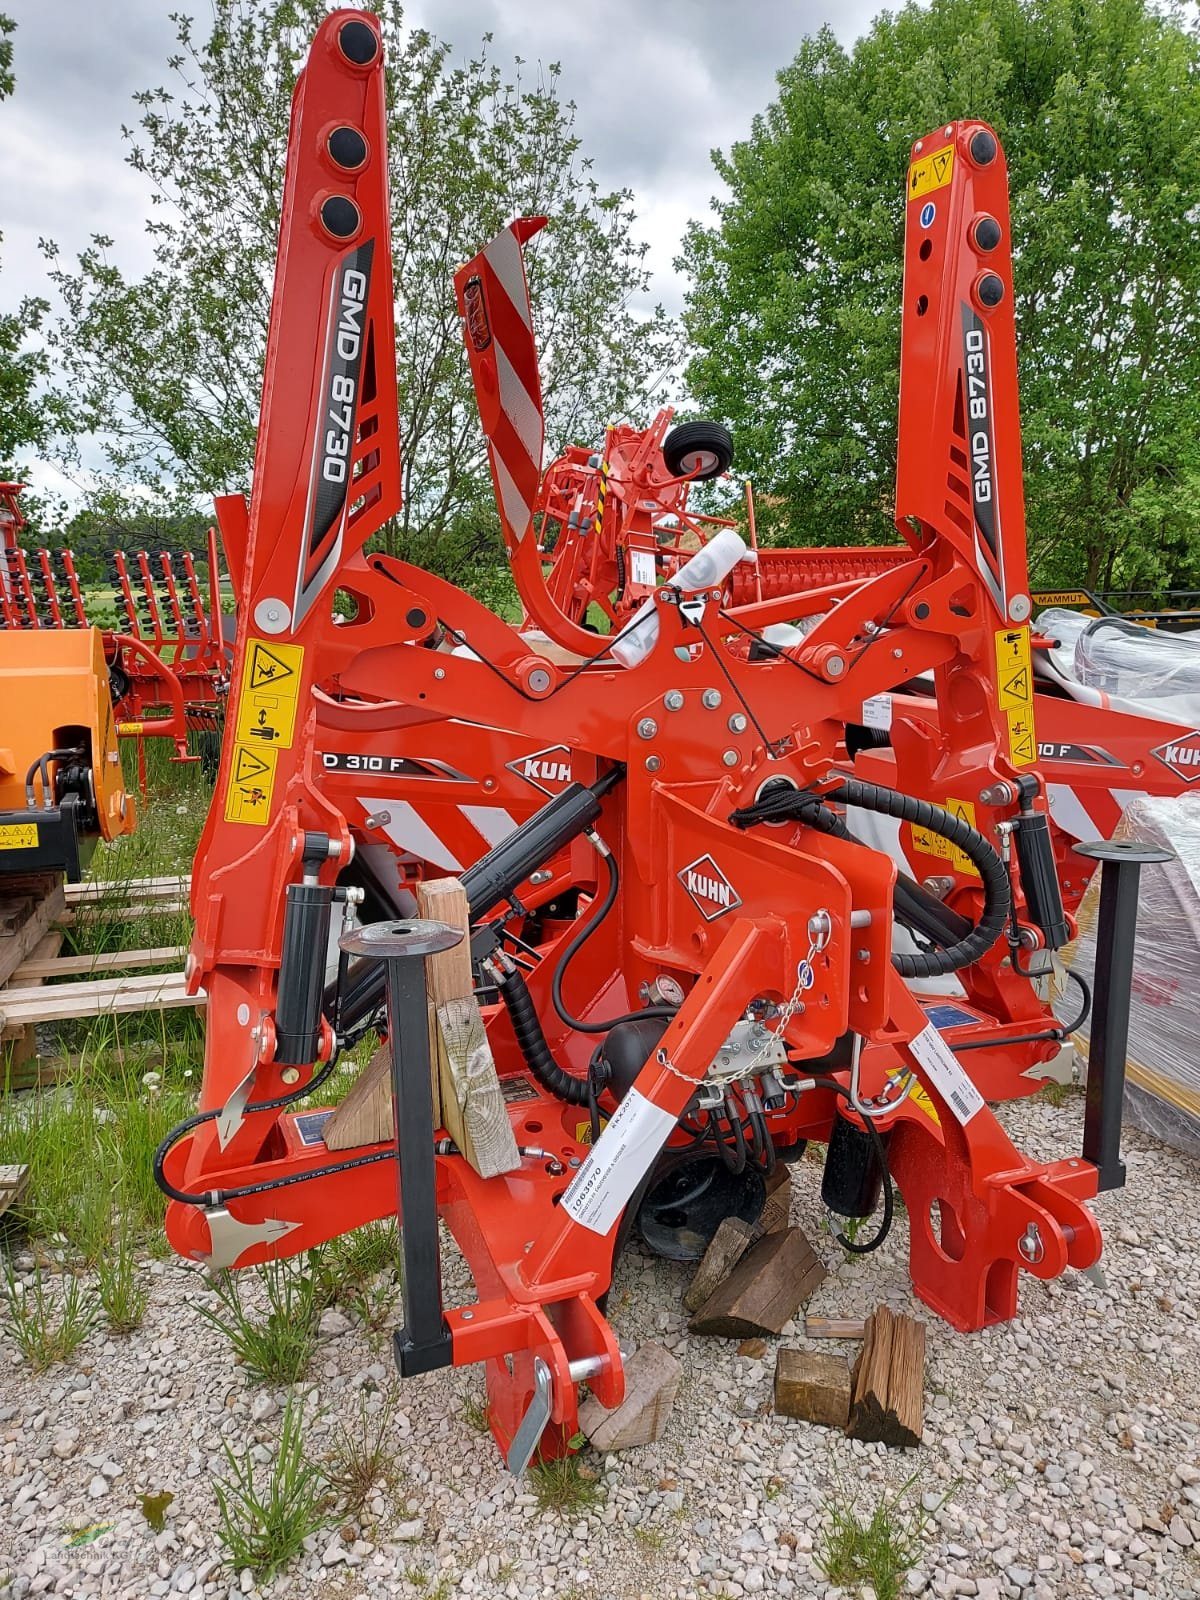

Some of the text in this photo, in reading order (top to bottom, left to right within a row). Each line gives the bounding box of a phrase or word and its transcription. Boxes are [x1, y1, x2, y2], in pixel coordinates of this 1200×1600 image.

[322, 269, 367, 484] GMD 8730
[965, 330, 991, 503] GMD 8730
[1038, 594, 1083, 604] MAMMUT
[1037, 743, 1072, 757] 10 F
[1165, 745, 1200, 766] KUH
[346, 755, 383, 770] 310
[390, 758, 404, 771] F
[524, 759, 572, 782] KUH
[687, 870, 730, 907] KUHN
[572, 1167, 602, 1212] 1063970
